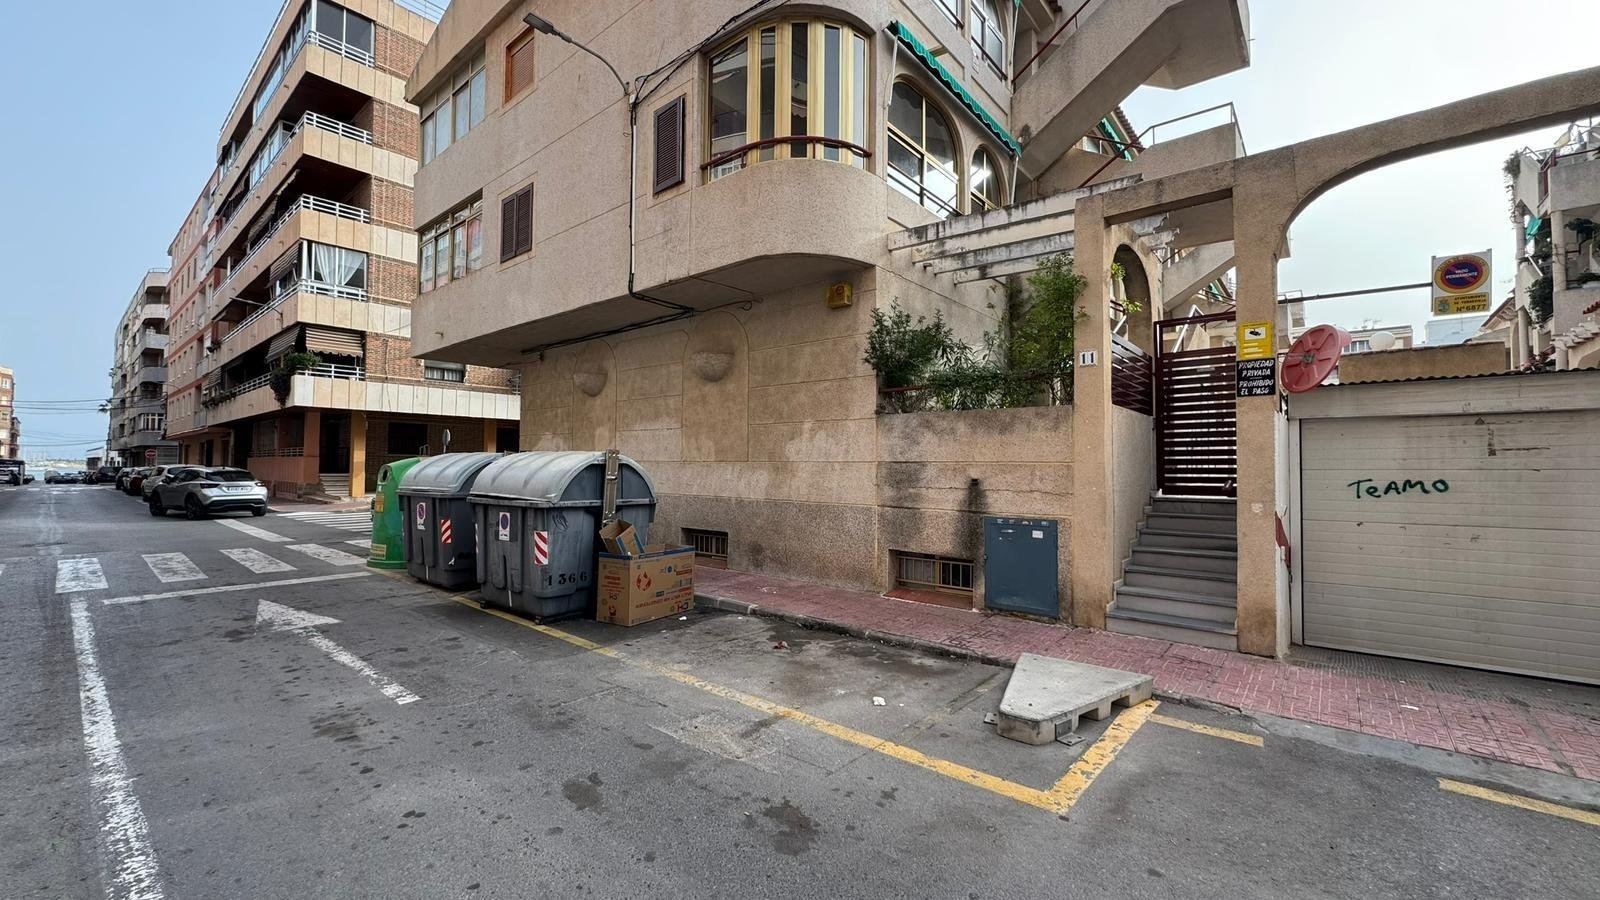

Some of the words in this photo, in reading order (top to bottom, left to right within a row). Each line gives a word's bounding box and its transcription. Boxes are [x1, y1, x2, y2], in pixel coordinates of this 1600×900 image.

[1082, 352, 1094, 364] 11
[1238, 359, 1275, 370] PROPIEDAD
[1242, 368, 1271, 378] PRIVADA
[1238, 378, 1274, 388] PROHIBIDO
[1240, 388, 1249, 396] EL
[1252, 386, 1270, 395] PASO
[545, 571, 588, 586] 1366
